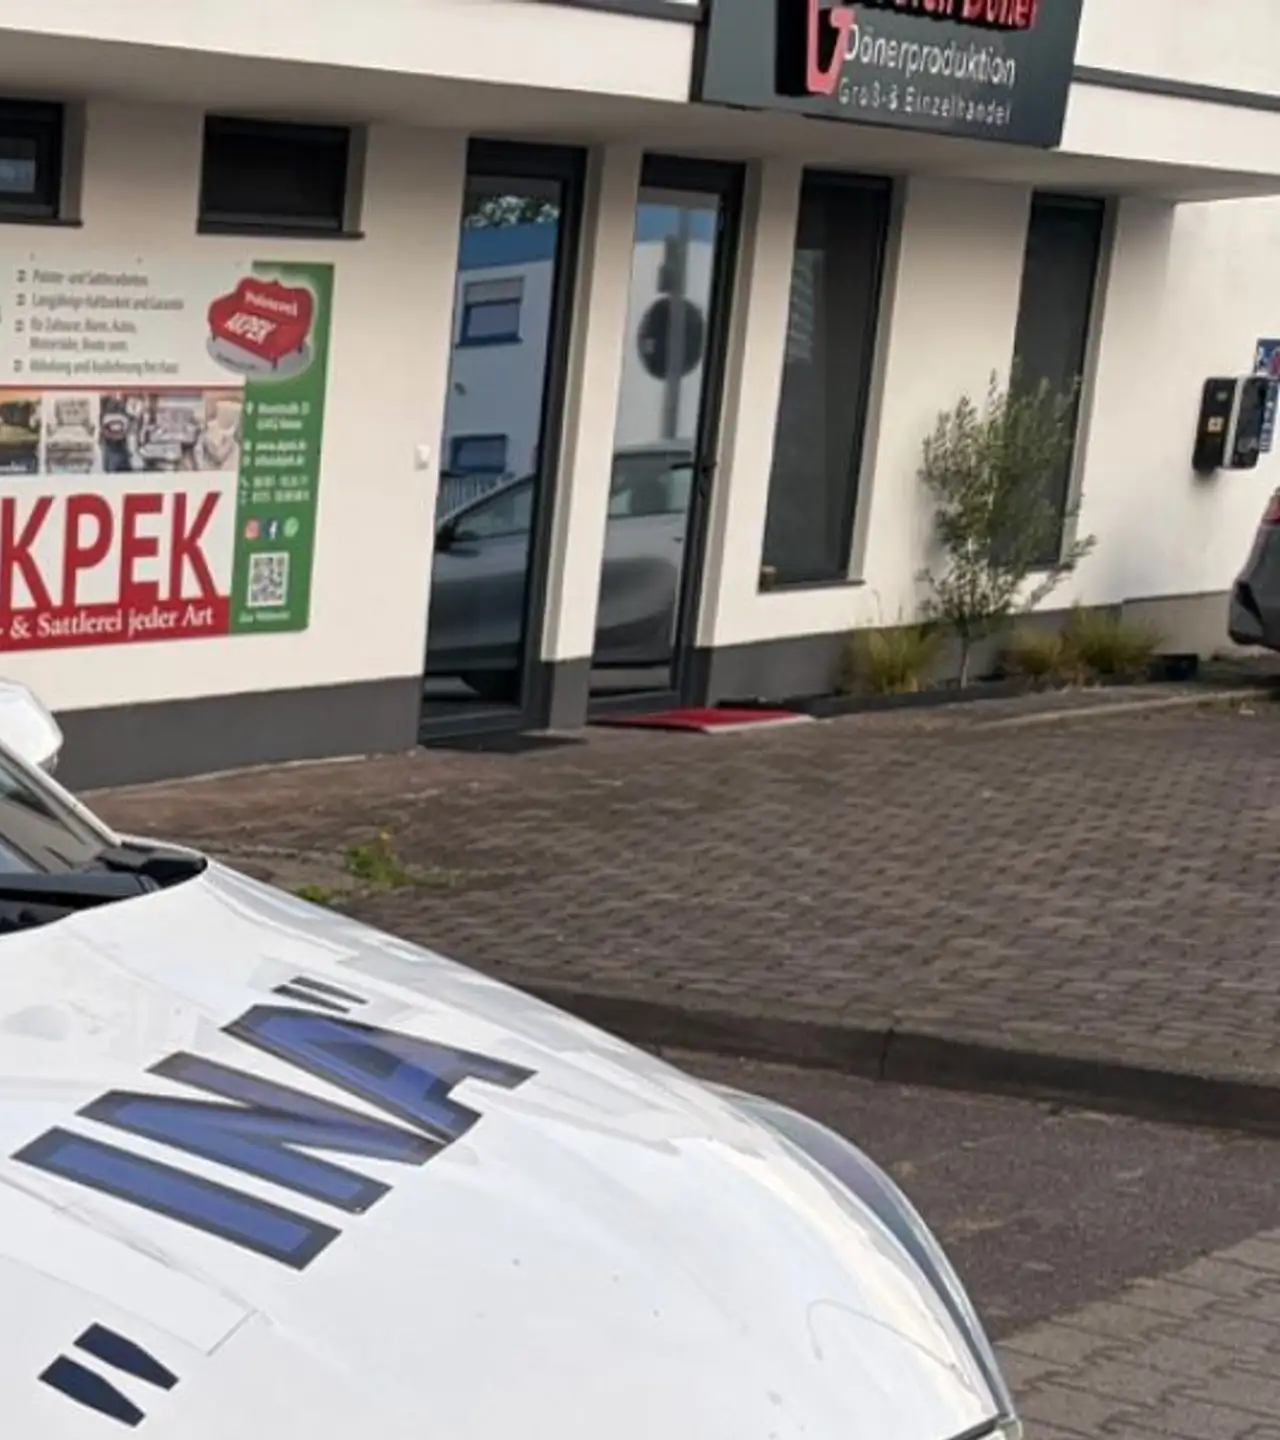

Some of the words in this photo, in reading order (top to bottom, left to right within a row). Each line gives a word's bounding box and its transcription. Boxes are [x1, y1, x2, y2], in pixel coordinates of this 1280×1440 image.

[843, 22, 1017, 89] Dönerproduktion
[904, 84, 1013, 126] Einzelhandel
[223, 311, 278, 345] AKPEK
[9, 615, 31, 641] &
[37, 611, 123, 638] Sattlerei
[127, 607, 176, 638] jeder
[180, 603, 215, 628] Art
